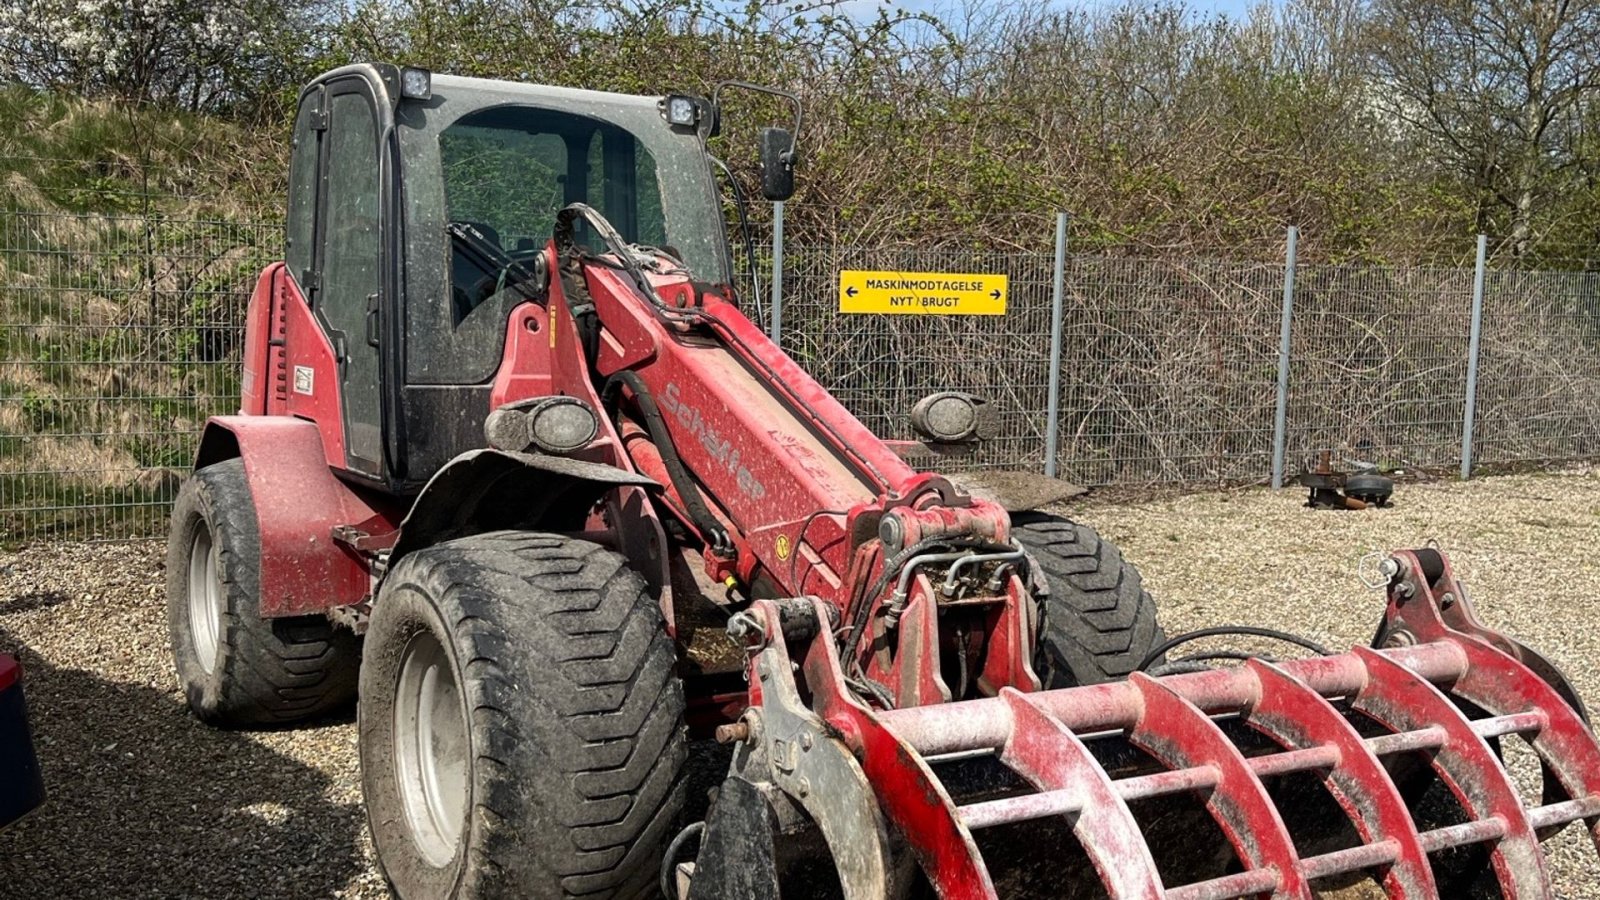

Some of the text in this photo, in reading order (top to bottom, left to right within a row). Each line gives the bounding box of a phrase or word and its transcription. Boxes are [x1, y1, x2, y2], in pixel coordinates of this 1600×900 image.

[866, 279, 983, 292] MASKINMODTAGELSE
[890, 296, 913, 306] NYT
[922, 296, 960, 307] BRUGT
